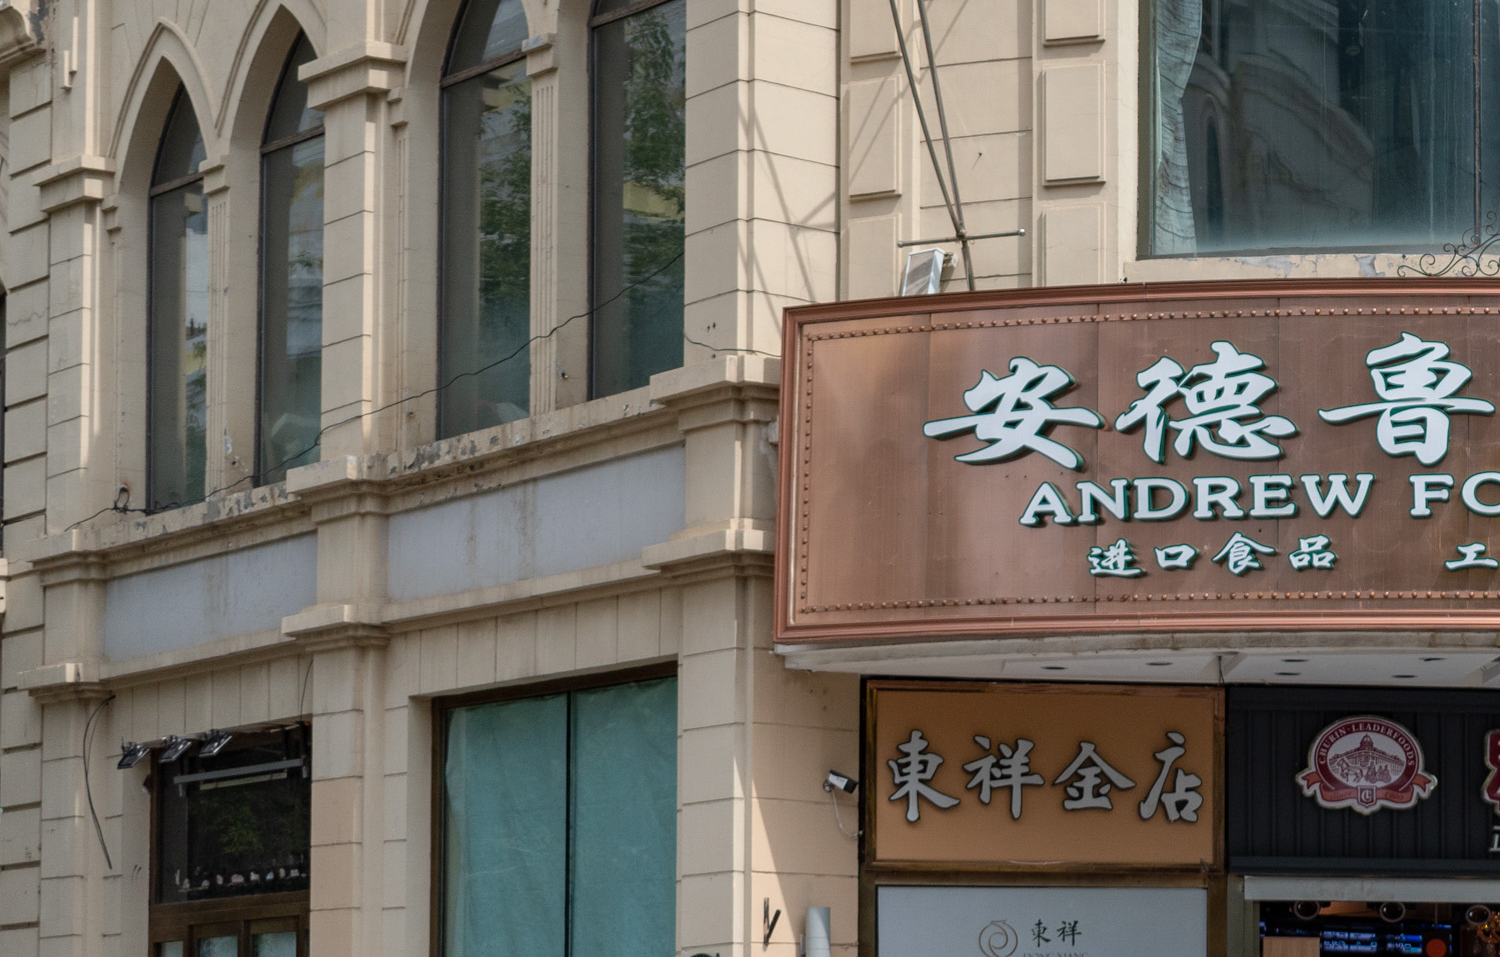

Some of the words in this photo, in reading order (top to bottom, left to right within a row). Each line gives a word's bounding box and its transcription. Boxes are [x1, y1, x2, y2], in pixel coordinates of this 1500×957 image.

[1019, 473, 1374, 526] ANDREW
[1087, 532, 1339, 579] 进口食品
[887, 729, 1204, 823] 東祥金店
[1031, 918, 1083, 948] 東祥
